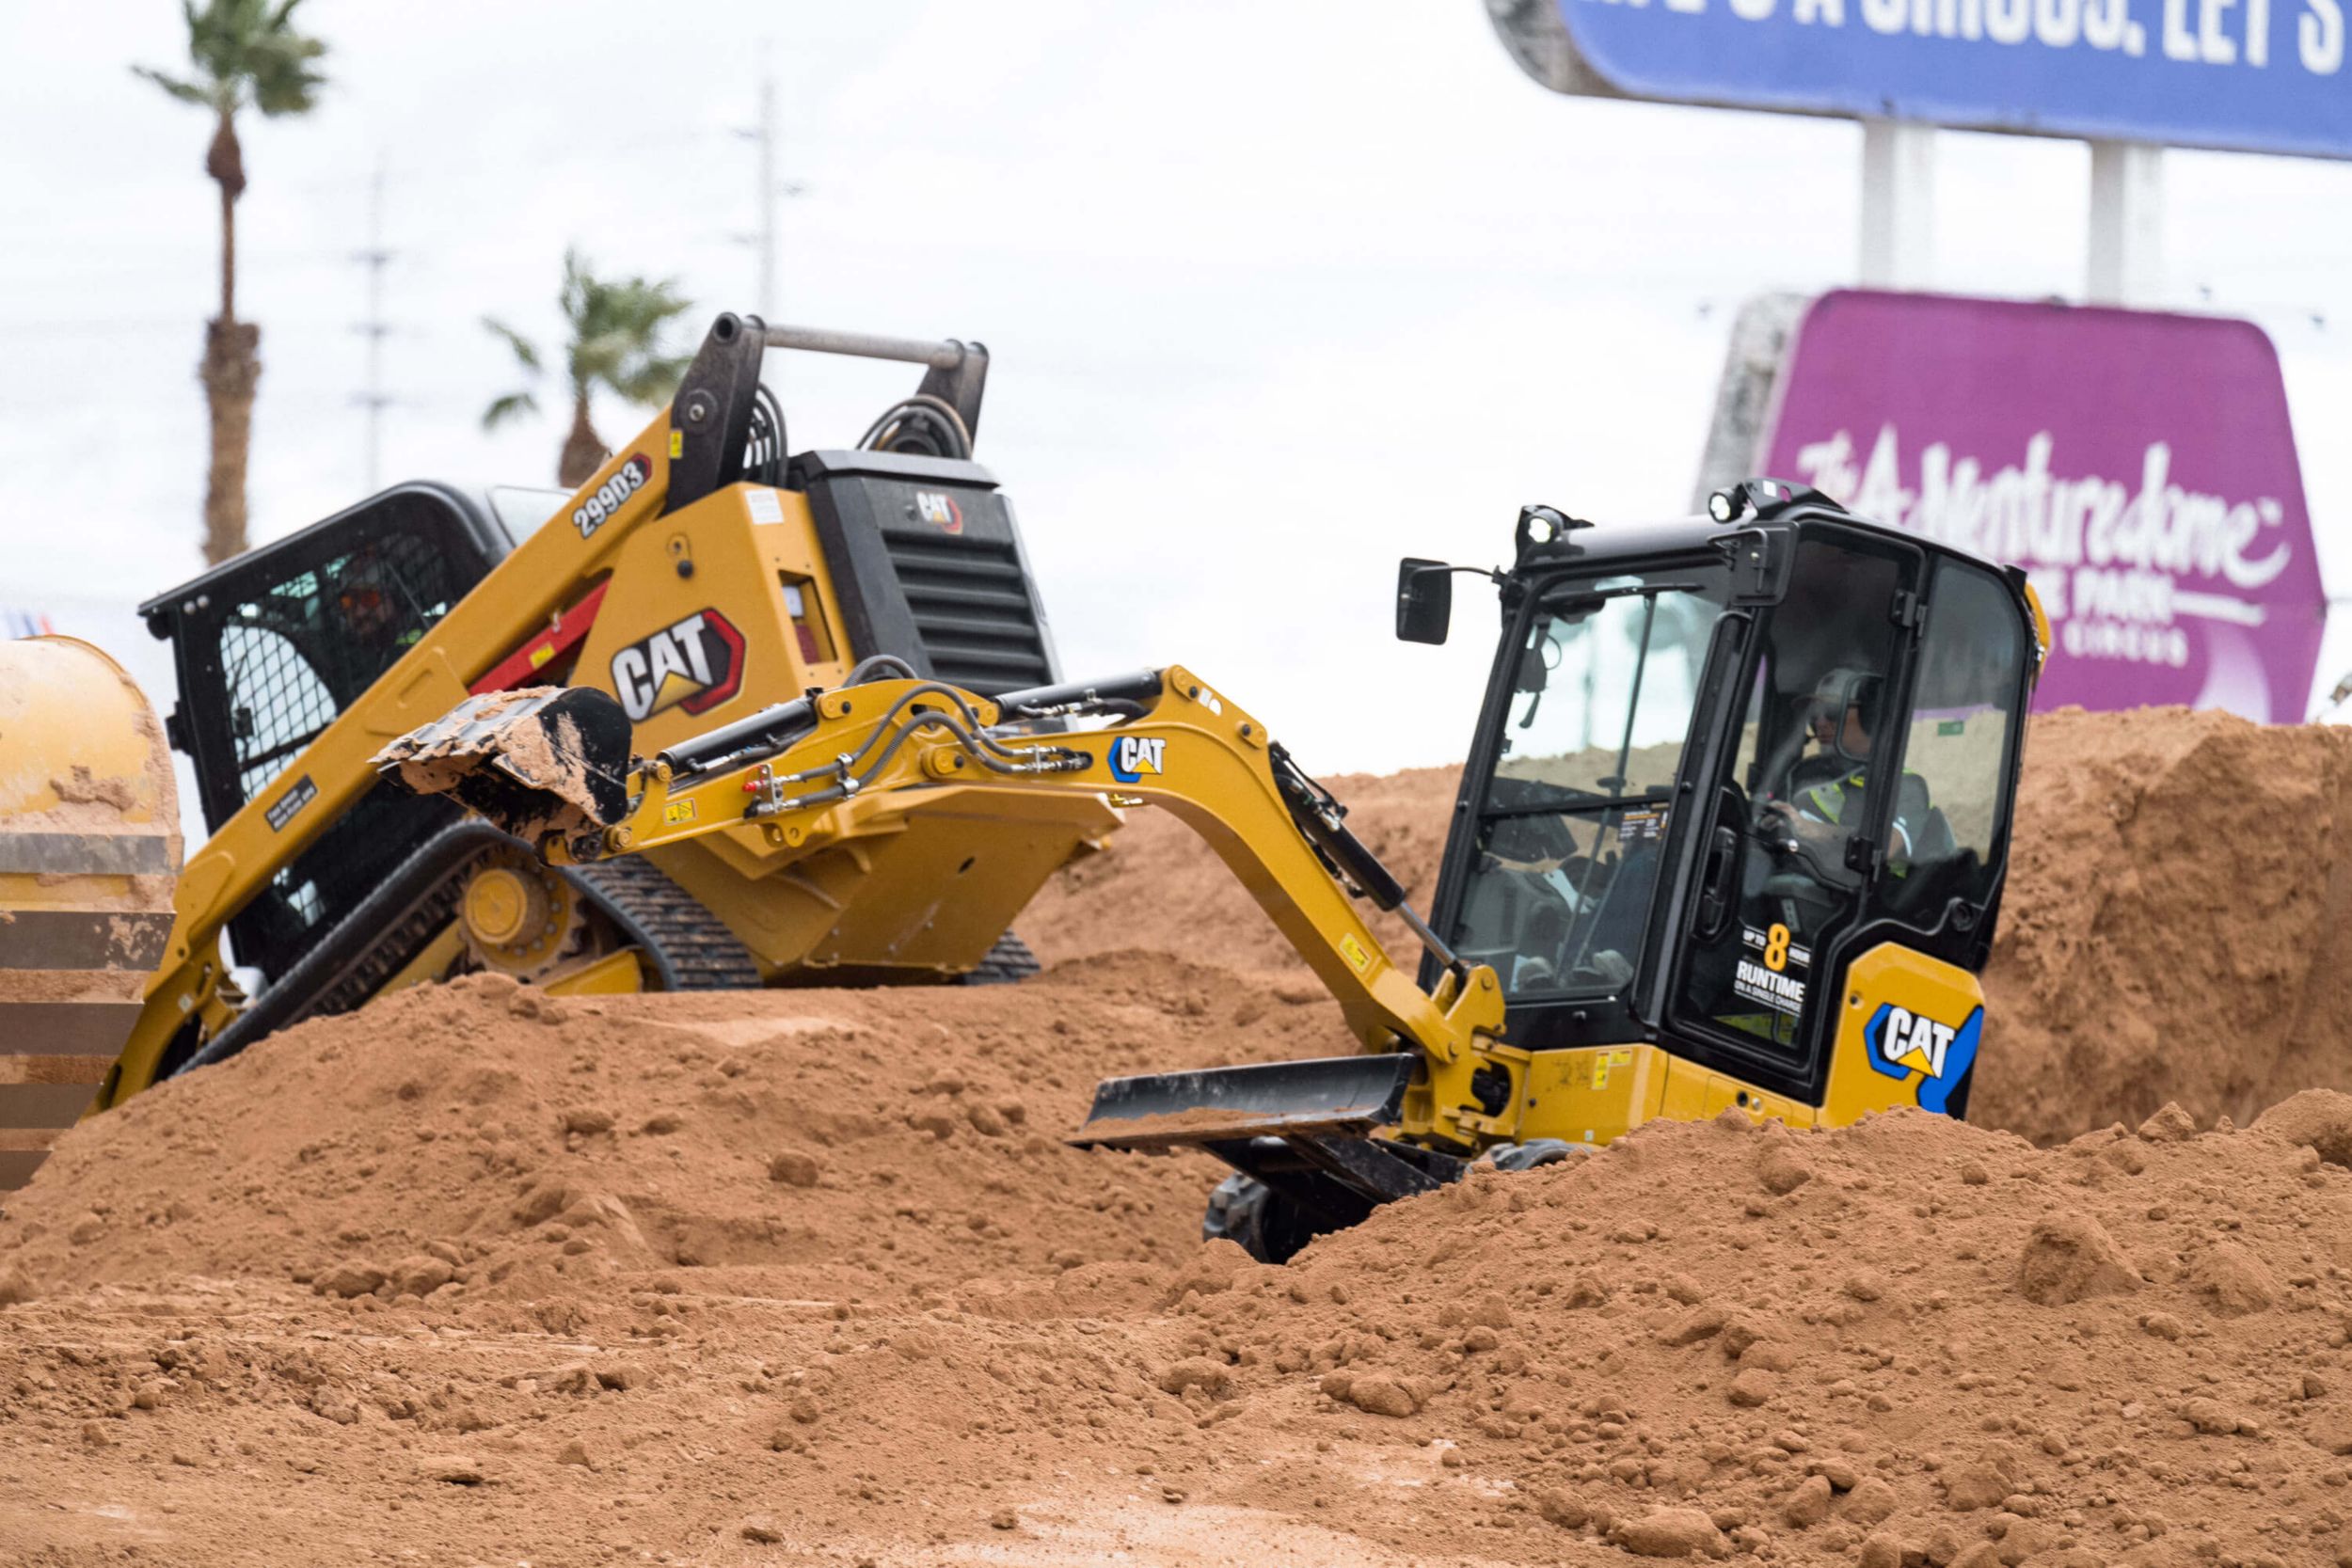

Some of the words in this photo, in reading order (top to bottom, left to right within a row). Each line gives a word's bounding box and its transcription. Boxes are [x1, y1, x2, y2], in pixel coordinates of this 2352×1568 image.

[572, 461, 644, 538] 299D3
[915, 490, 952, 524] CAT
[611, 612, 714, 721] CAT
[1120, 736, 1167, 774] CAT
[1764, 923, 1790, 972] 8
[1736, 960, 1806, 1003] RUNTIME
[1883, 1006, 1956, 1079] CAT
